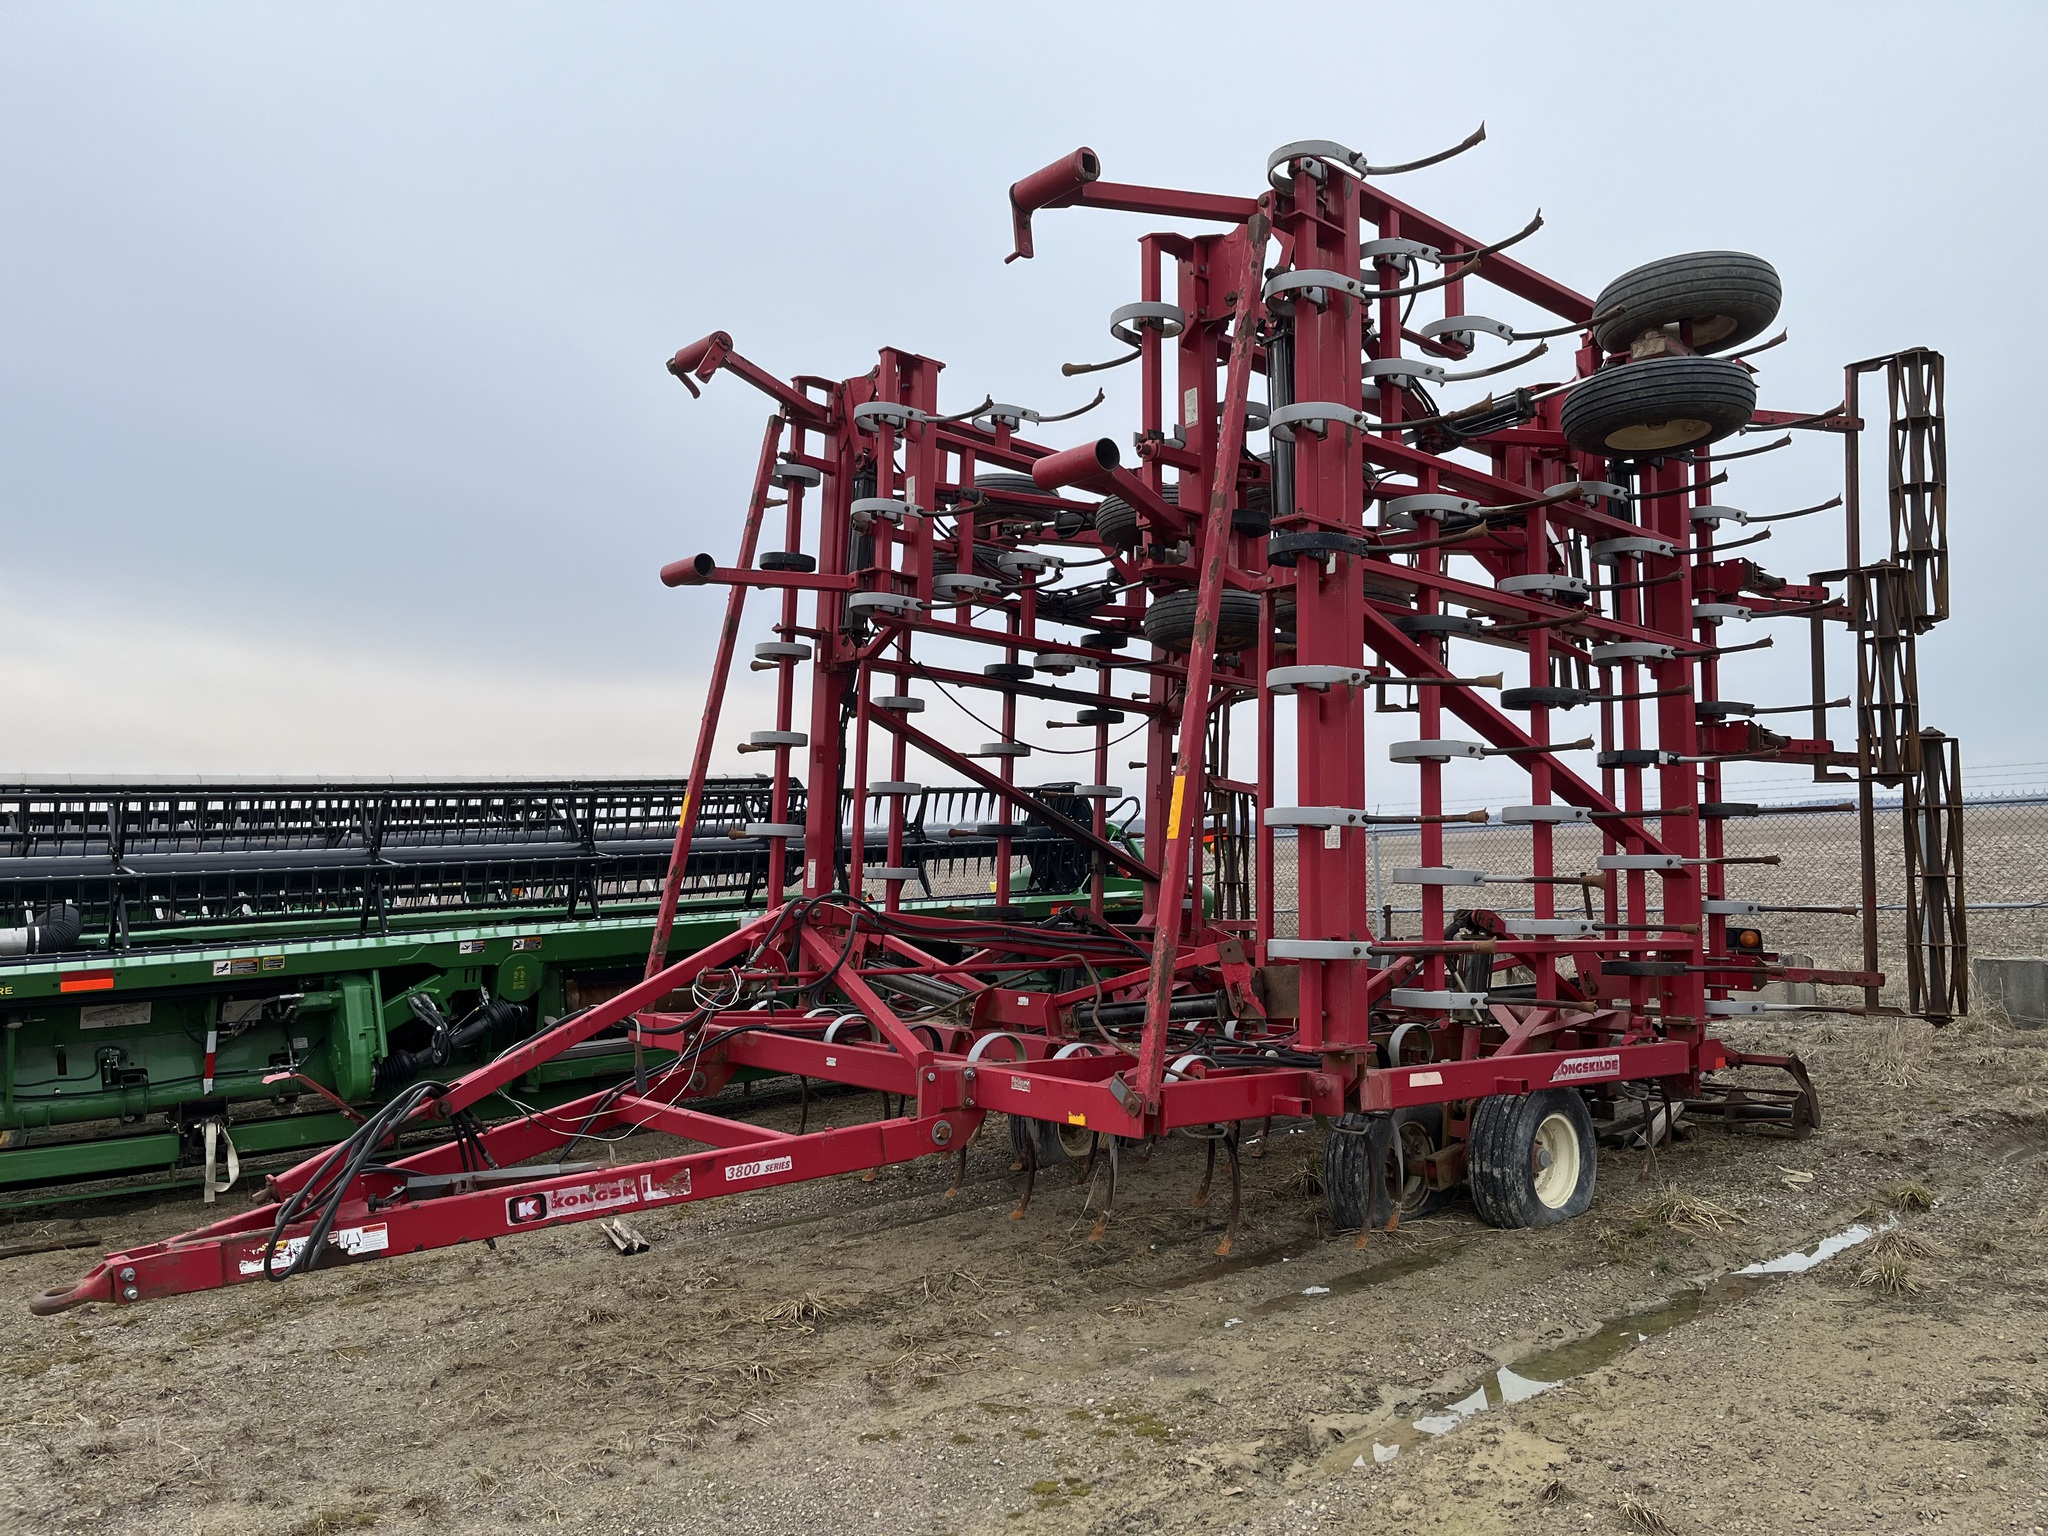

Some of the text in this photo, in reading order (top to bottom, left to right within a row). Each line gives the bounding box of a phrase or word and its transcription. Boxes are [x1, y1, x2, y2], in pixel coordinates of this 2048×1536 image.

[1556, 1060, 1618, 1076] ONGSKILDE
[727, 1160, 791, 1180] 3800 SERIES
[518, 1200, 537, 1217] K
